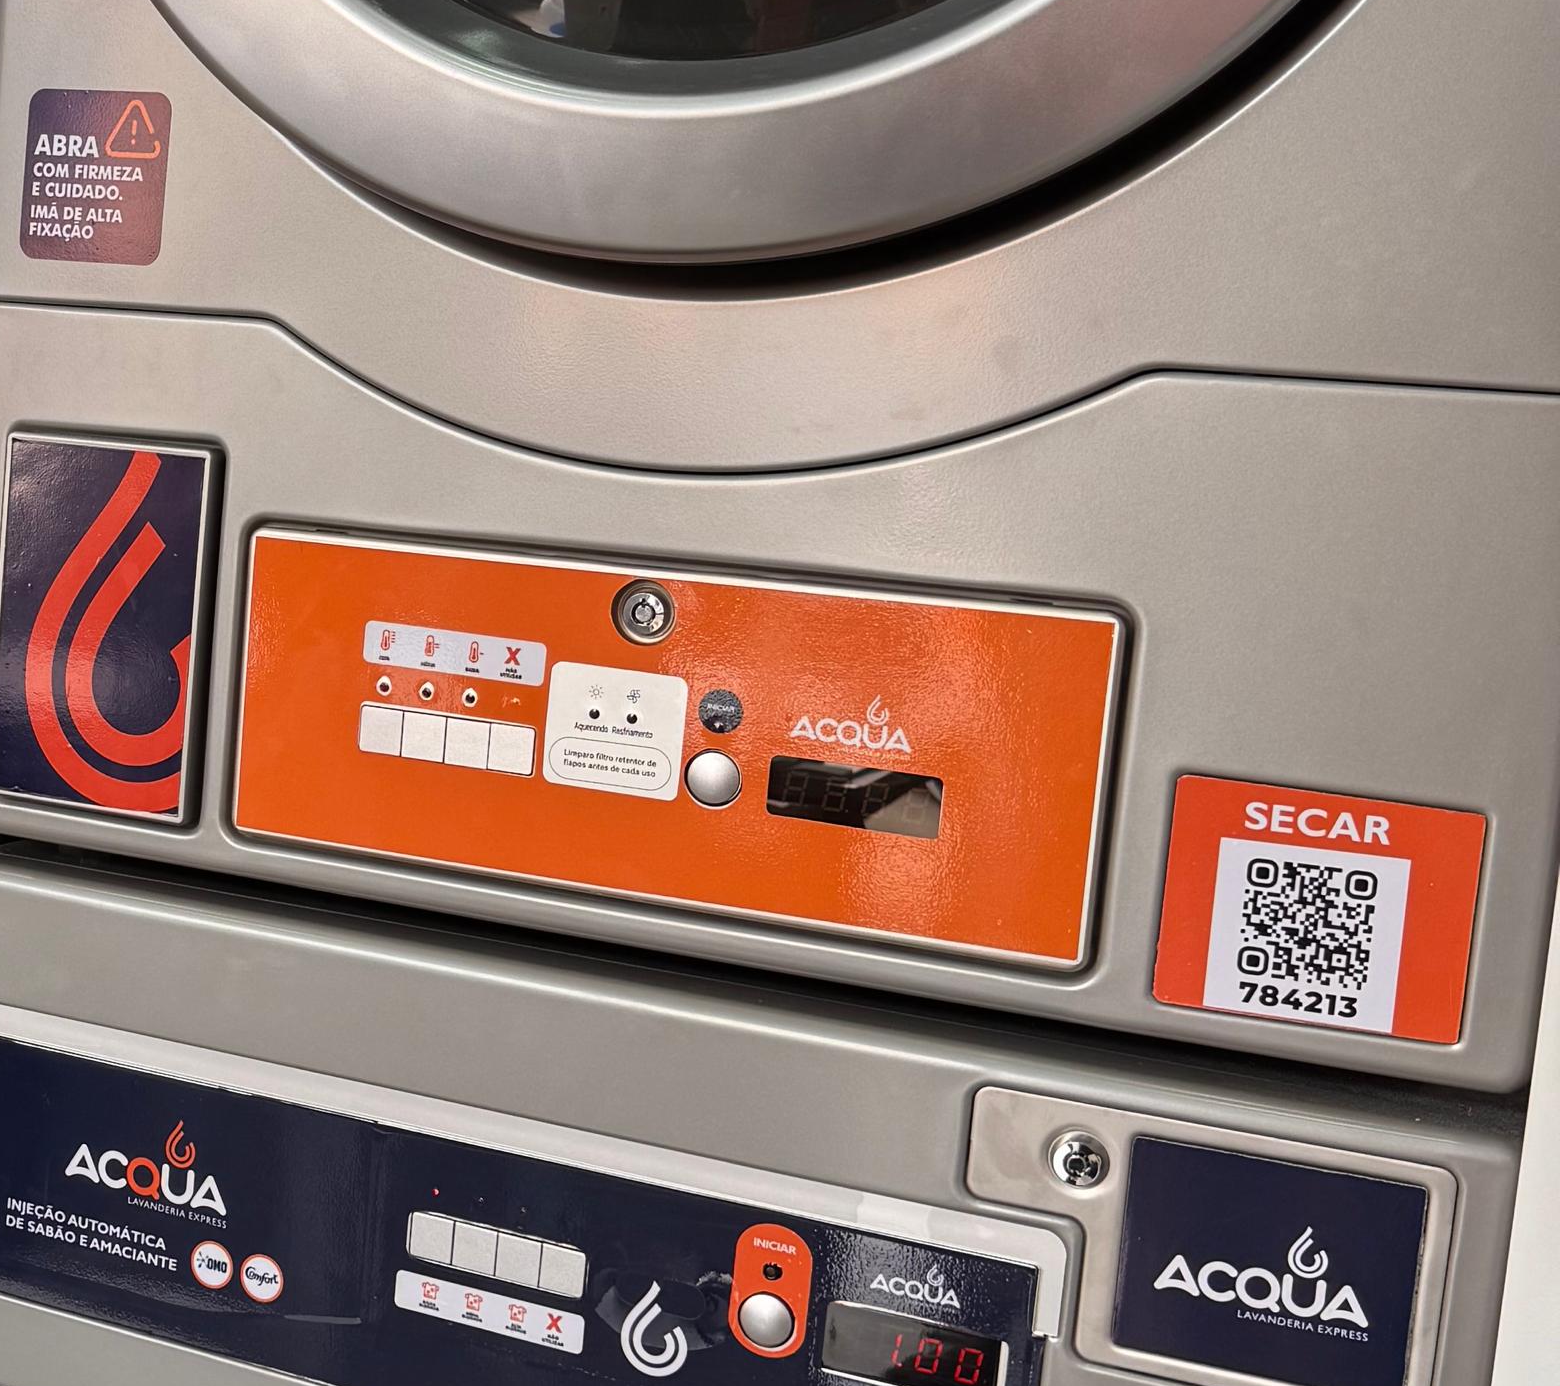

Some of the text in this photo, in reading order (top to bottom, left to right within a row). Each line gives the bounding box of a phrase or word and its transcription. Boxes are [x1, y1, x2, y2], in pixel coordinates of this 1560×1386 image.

[34, 134, 99, 158] ABRA
[33, 162, 143, 181] COM FIRMEZA
[31, 182, 123, 200] E CUIDADO.
[30, 203, 123, 223] IMÃ DE ALTA
[29, 221, 94, 241] FIXAÇÃO
[790, 715, 912, 754] ACQUA
[1244, 801, 1390, 845] SECAR
[1239, 981, 1358, 1018] 784213
[65, 1143, 227, 1217] ACQUA
[7, 1197, 167, 1250] INJEÇÃO AUTOMÁTICA
[127, 1196, 227, 1229] LAVANDERIA EXPRESS
[6, 1215, 178, 1271] DE SABÃO E AMACIANTE
[753, 1237, 797, 1255] INICIAR
[207, 1259, 228, 1274] OMO
[245, 1266, 279, 1286] Comfort
[870, 1274, 960, 1309] ACQUA
[1153, 1254, 1369, 1328] ACQUA
[1237, 1310, 1369, 1342] LAVANDERIA EXPRESS
[891, 1334, 984, 1386] 100
